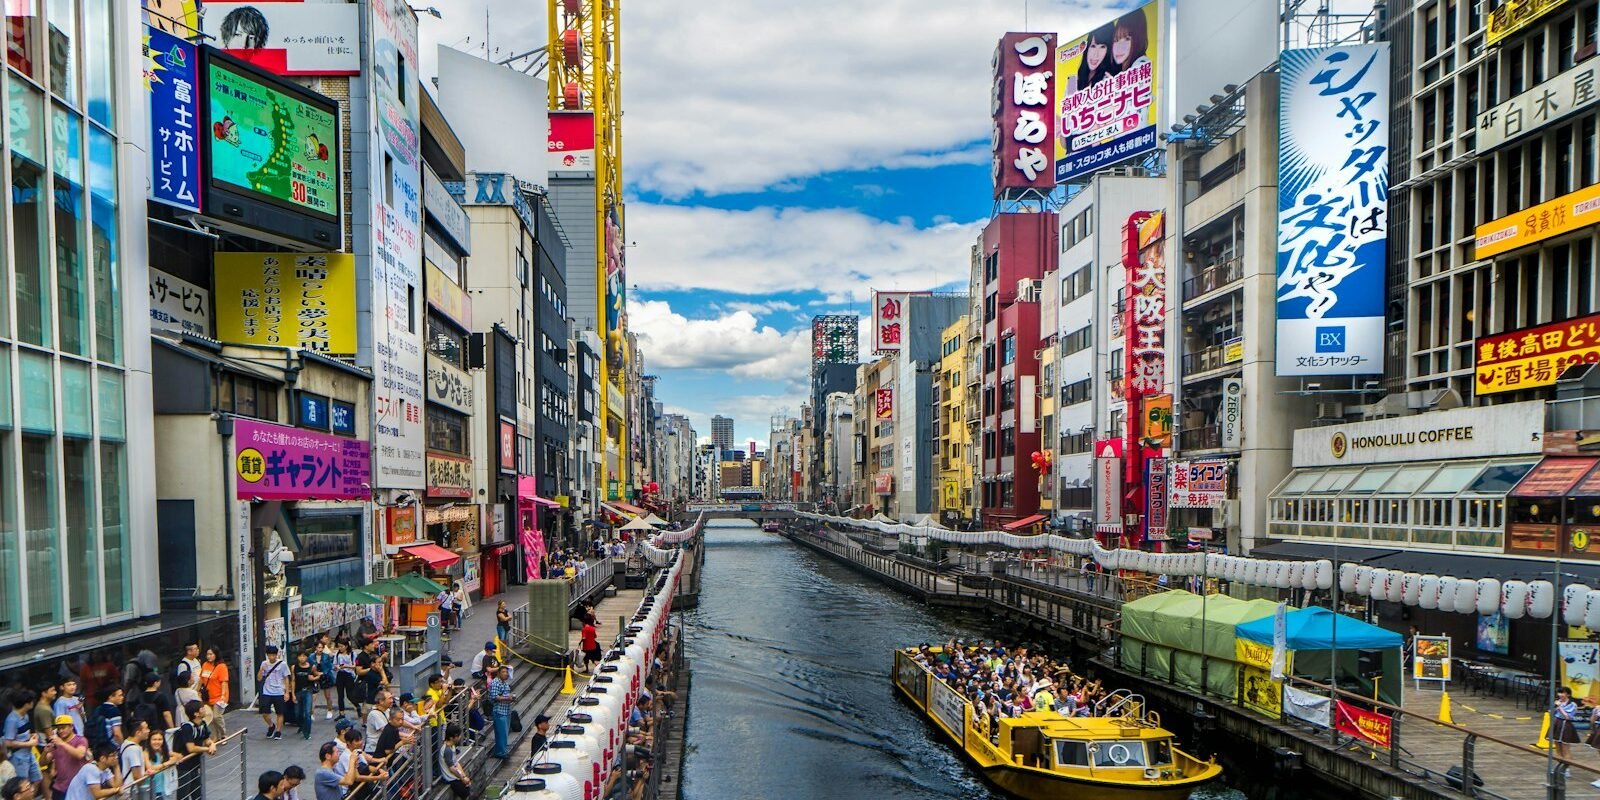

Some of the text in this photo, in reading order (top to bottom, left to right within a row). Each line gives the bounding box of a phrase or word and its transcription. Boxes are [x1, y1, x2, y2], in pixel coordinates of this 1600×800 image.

[283, 36, 345, 44] めっちゃ面白いを
[1062, 62, 1152, 113] 高収入お仕事情報
[1014, 33, 1053, 181] づぼらや
[1062, 80, 1151, 135] いちごナビ
[1481, 69, 1596, 138] 4F 白木屋
[173, 78, 195, 203] 富士ホーム
[1074, 125, 1119, 148] いちごナビ 求人
[1309, 47, 1386, 238] シャッターは
[159, 127, 173, 192] サービス
[292, 180, 306, 203] 30
[242, 289, 260, 336] 応援します
[296, 256, 331, 352] 素晴らしい夢の実現
[1132, 260, 1167, 392] 大阪王将
[1320, 333, 1341, 346] BX
[1296, 355, 1368, 367] 文化シャッター
[1497, 359, 1552, 386] 酒場
[308, 400, 316, 422] 酒
[1227, 397, 1237, 422] ZERO
[252, 430, 341, 453] あなたも憧れのお店のオーナーに!
[1352, 426, 1474, 449] HONOLULU COFFEE
[240, 455, 263, 475] 賃貸
[266, 449, 342, 489] ギャラント
[1190, 466, 1224, 482] ダイコク
[1174, 467, 1188, 490] 薬
[1187, 493, 1209, 506] 免税
